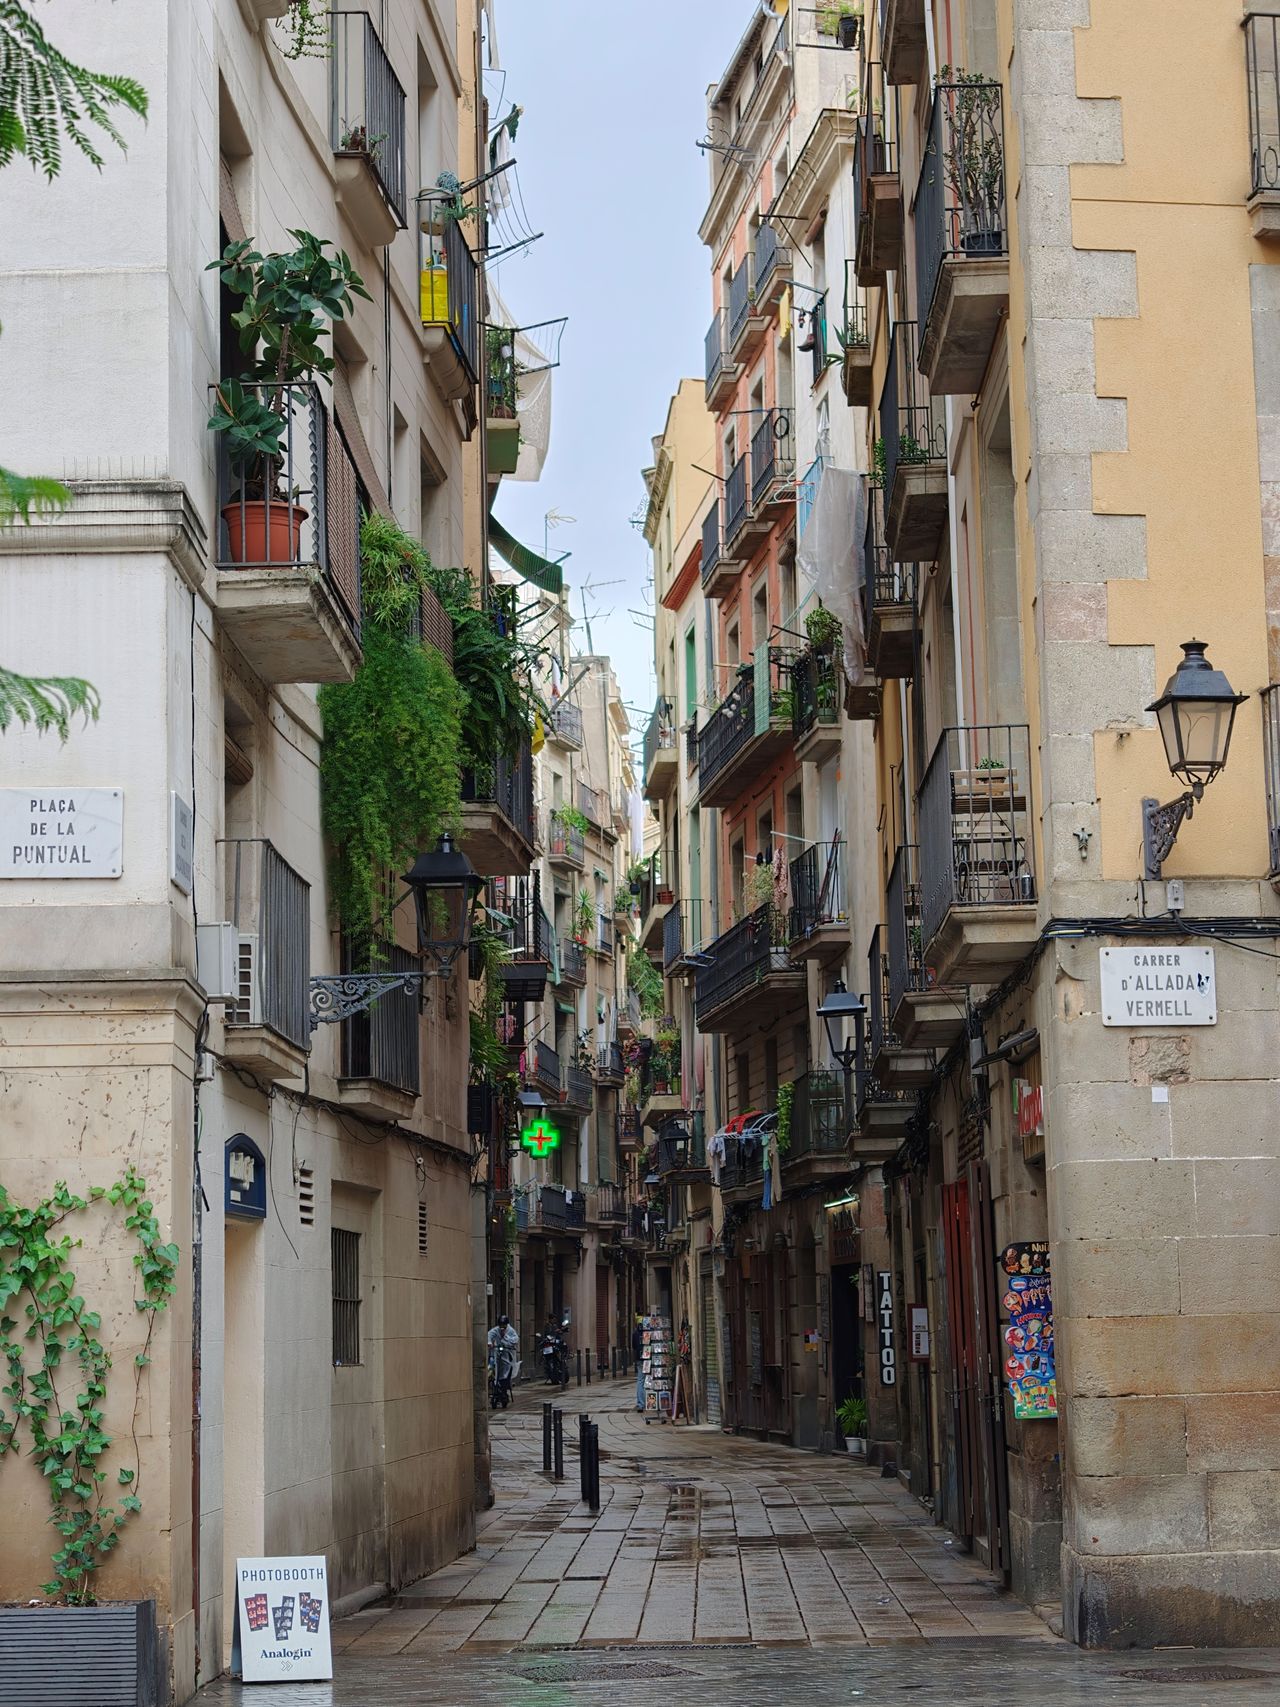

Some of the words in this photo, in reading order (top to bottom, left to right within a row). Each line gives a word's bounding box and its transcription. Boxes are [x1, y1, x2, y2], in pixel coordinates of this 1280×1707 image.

[30, 799, 76, 814] PLAÇA
[30, 822, 47, 836] DE
[57, 822, 75, 836] LA
[13, 845, 92, 864] PUNTUAL
[1134, 954, 1181, 966] CARRER
[1126, 1000, 1192, 1017] VERMELL
[879, 1272, 896, 1385] TATTOO
[242, 1568, 324, 1582] PHOTOBOOTH
